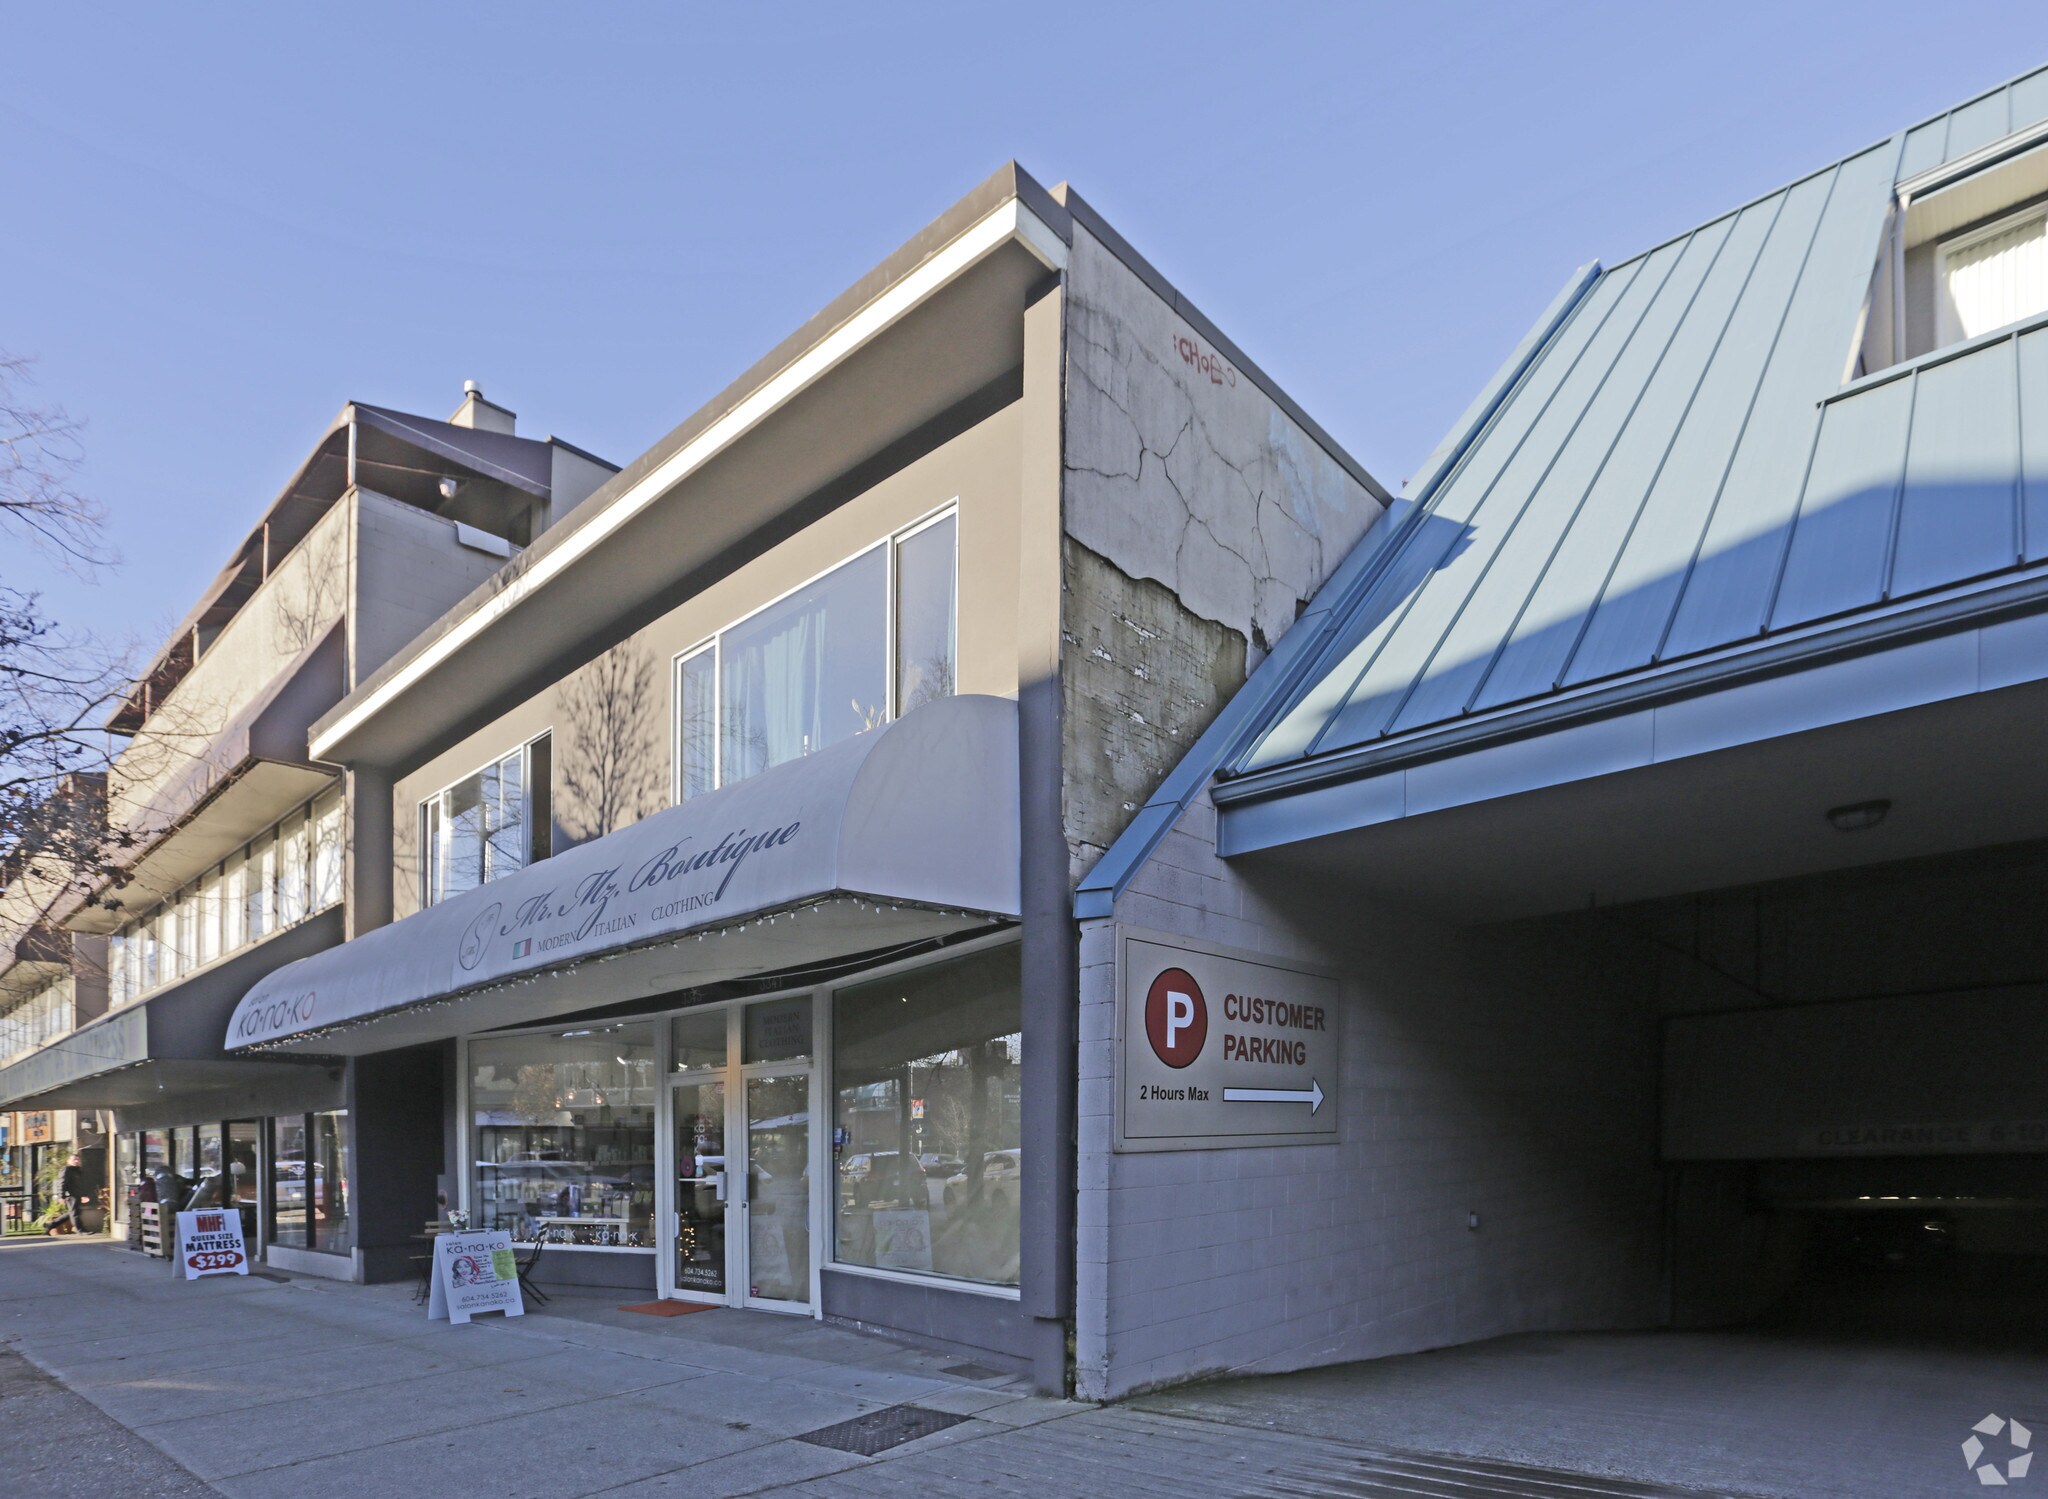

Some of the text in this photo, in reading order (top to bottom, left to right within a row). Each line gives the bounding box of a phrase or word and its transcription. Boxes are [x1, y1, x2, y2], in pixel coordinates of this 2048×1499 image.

[500, 886, 558, 936] Mr.
[628, 821, 801, 902] Boutique
[537, 891, 714, 953] MODERN ITALIAN CLOTHING
[1166, 990, 1195, 1049] P
[1223, 993, 1326, 1031] CUSTOMER
[1223, 1034, 1307, 1066] PARKING
[1140, 1085, 1209, 1101] 2 Hours Max
[1818, 1127, 1972, 1147] CLEARANCE
[185, 1239, 241, 1252] MATTRESS
[190, 1234, 215, 1242] QUEEN
[196, 1253, 236, 1268] $299
[684, 1267, 718, 1278] 604.734.5262
[456, 1297, 515, 1311] salonkanako.ca
[461, 1291, 508, 1303] 604.734.5262
